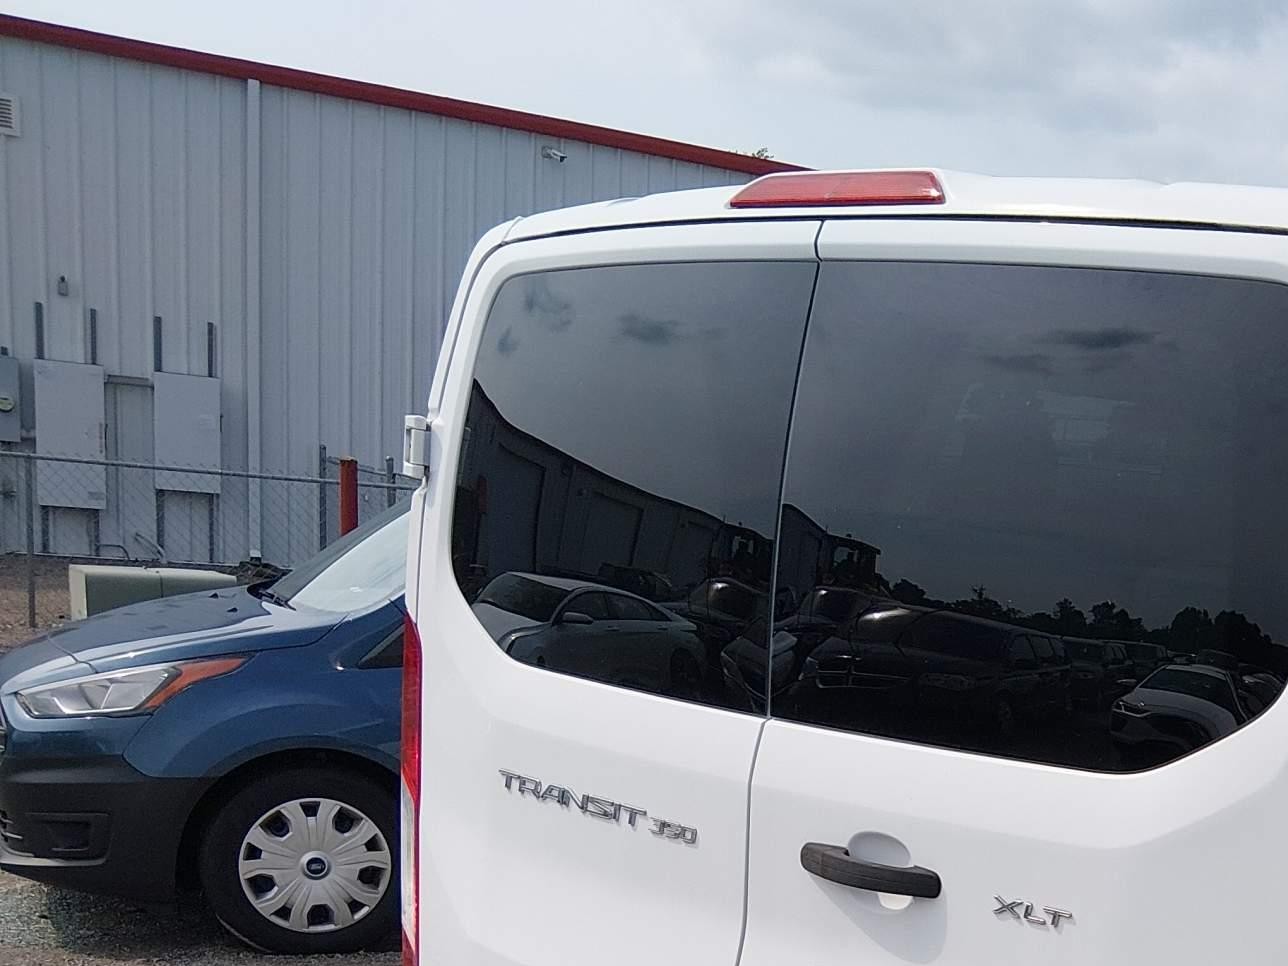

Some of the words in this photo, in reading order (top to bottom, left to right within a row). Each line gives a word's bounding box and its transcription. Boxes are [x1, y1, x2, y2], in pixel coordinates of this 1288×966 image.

[499, 768, 647, 827] TRANSIT
[648, 817, 697, 844] 350
[993, 895, 1072, 928] XLT
